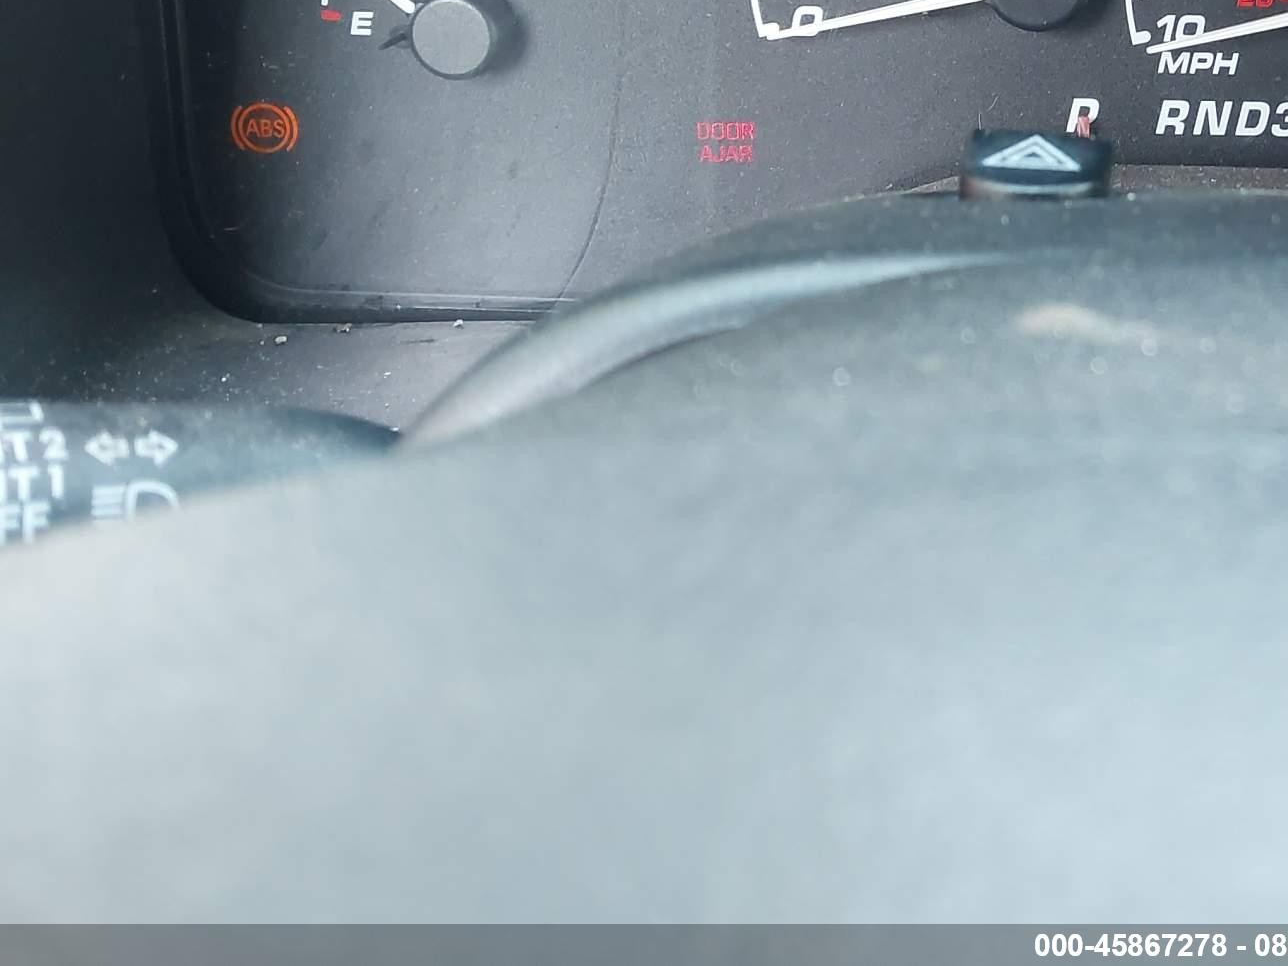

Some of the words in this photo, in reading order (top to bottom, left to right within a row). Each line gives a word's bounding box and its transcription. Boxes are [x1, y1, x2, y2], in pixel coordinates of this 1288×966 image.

[350, 11, 374, 35] E
[791, 6, 824, 36] 0
[1155, 15, 1206, 42] 10
[1156, 52, 1239, 74] MPH
[245, 118, 285, 138] ABS
[697, 122, 755, 140] DOOR
[700, 144, 754, 162] AJAR
